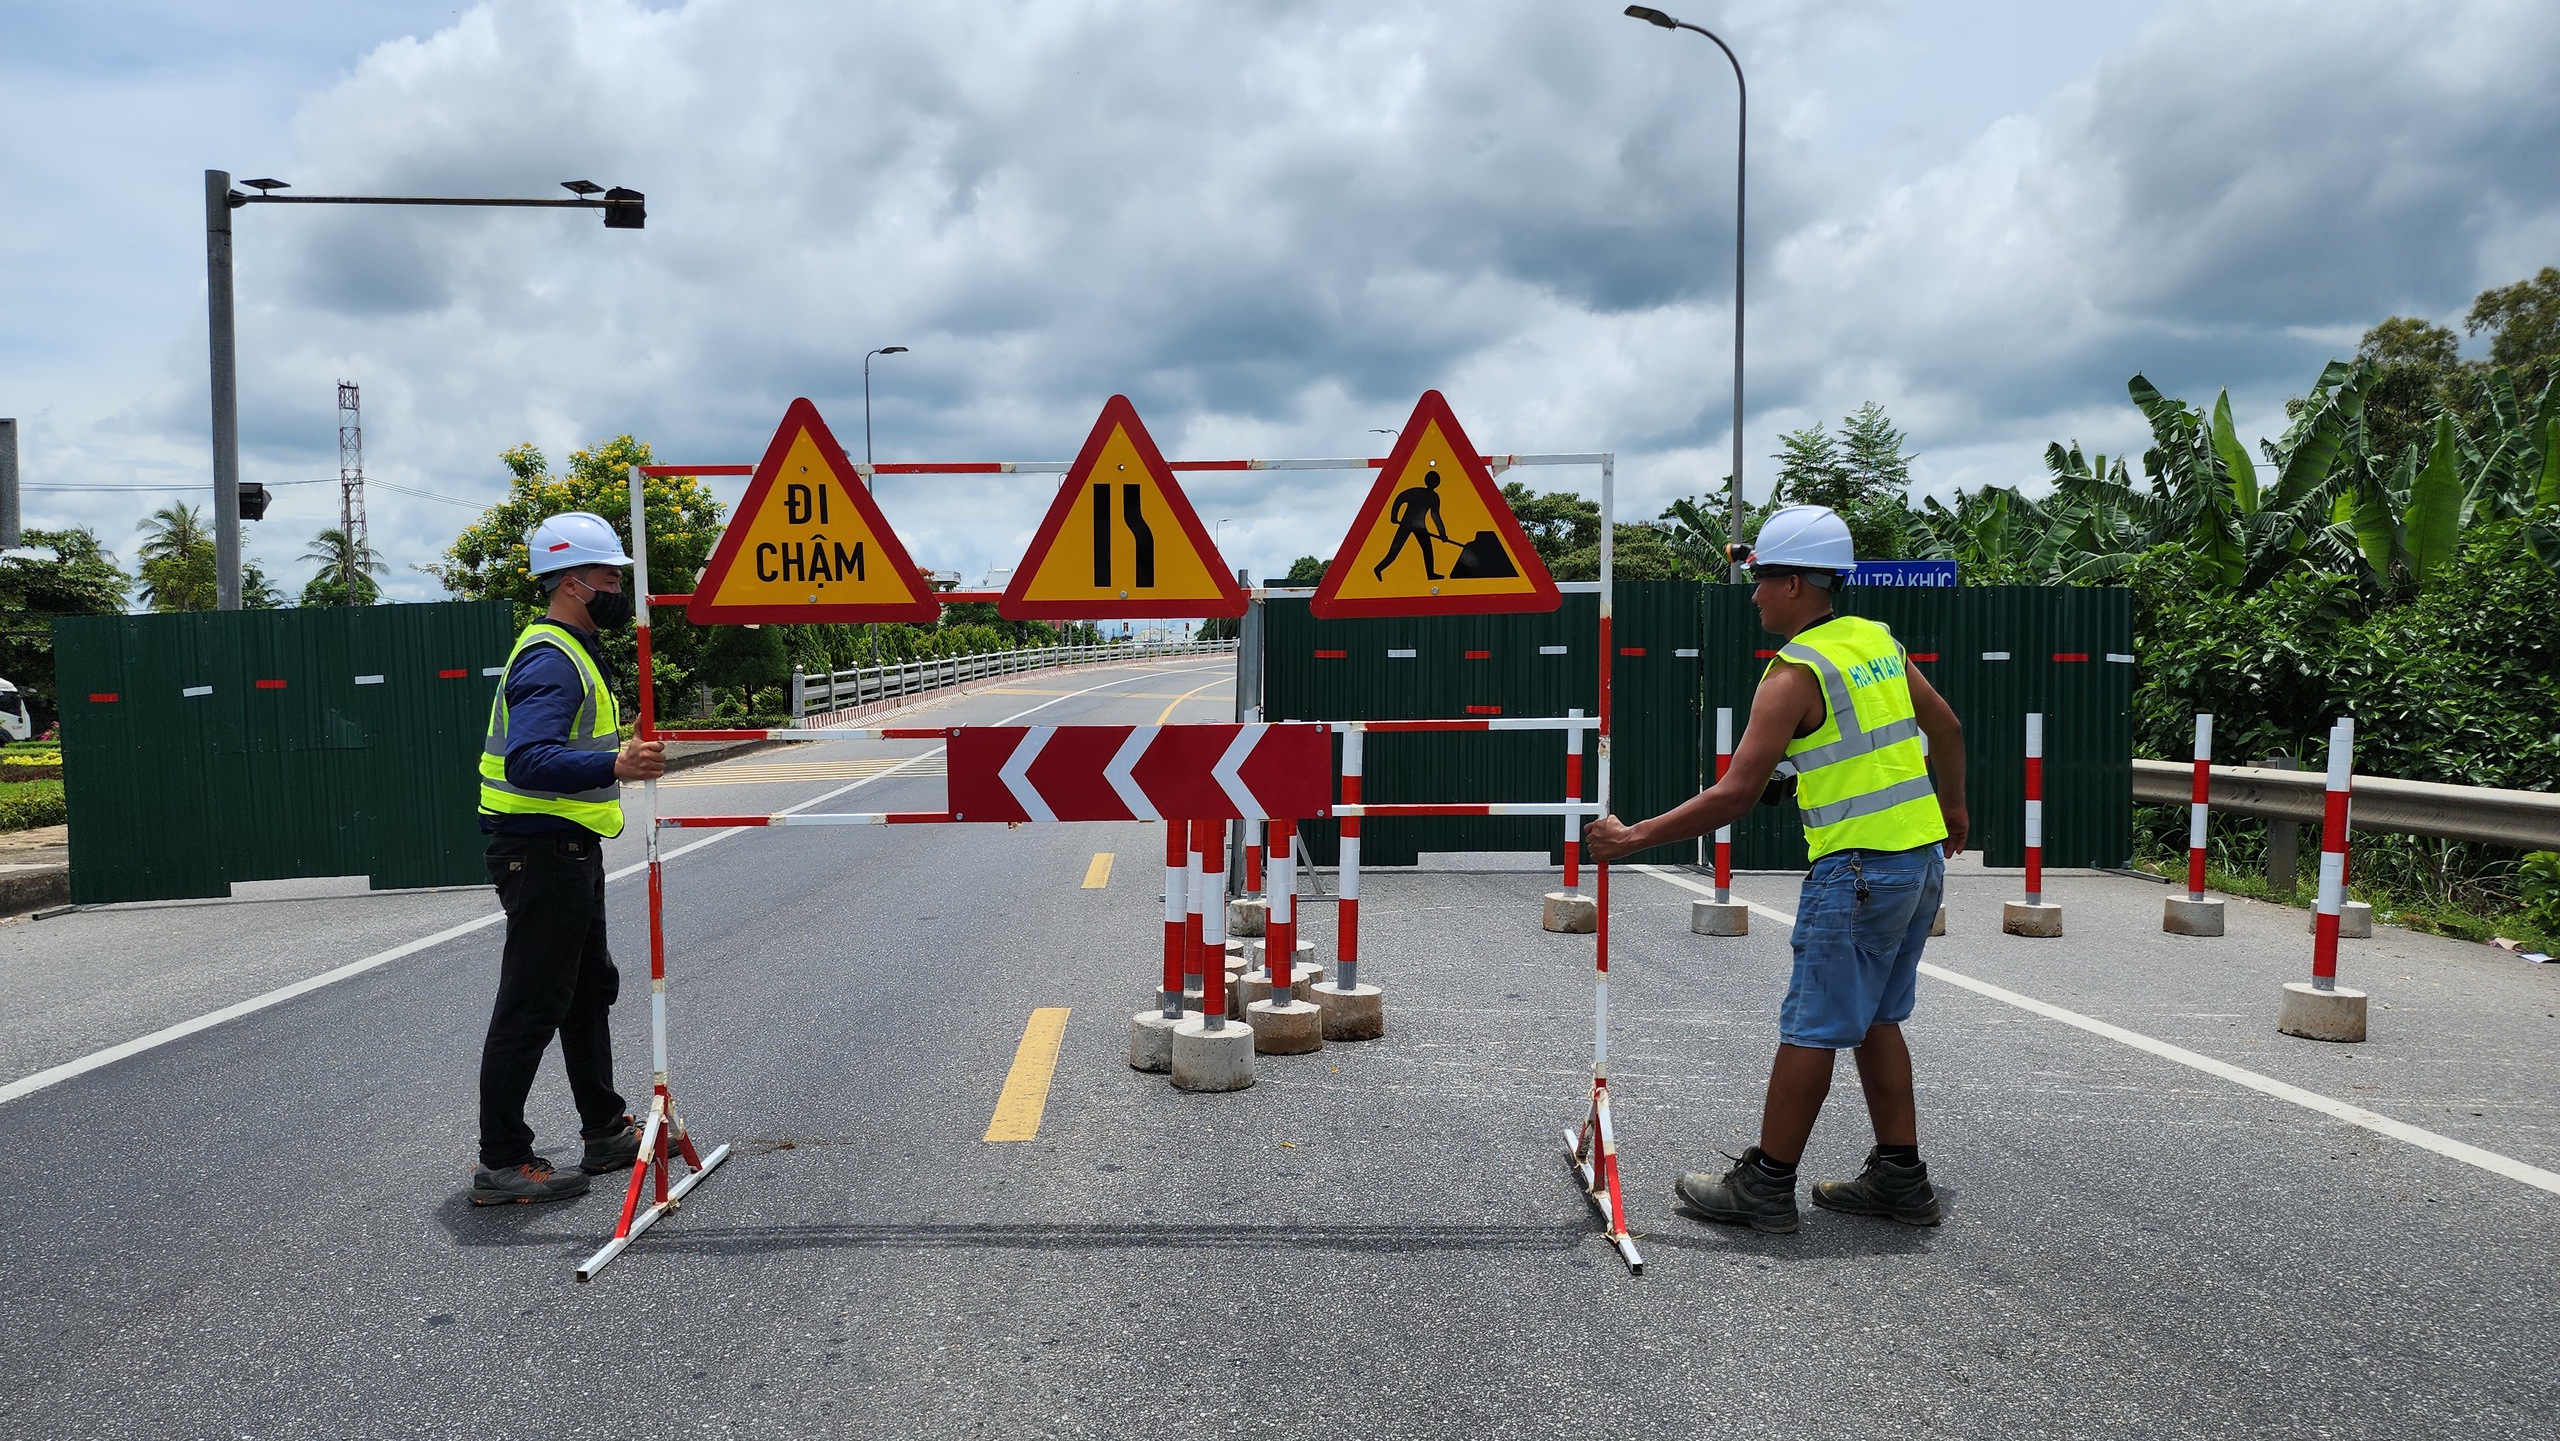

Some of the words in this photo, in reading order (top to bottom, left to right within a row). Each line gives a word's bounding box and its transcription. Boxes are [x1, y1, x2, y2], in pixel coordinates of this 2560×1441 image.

[784, 484, 829, 525] ĐI
[756, 534, 866, 589] CHẬM
[1872, 568, 1905, 587] TRÀ
[1908, 566, 1952, 587] KHÚC
